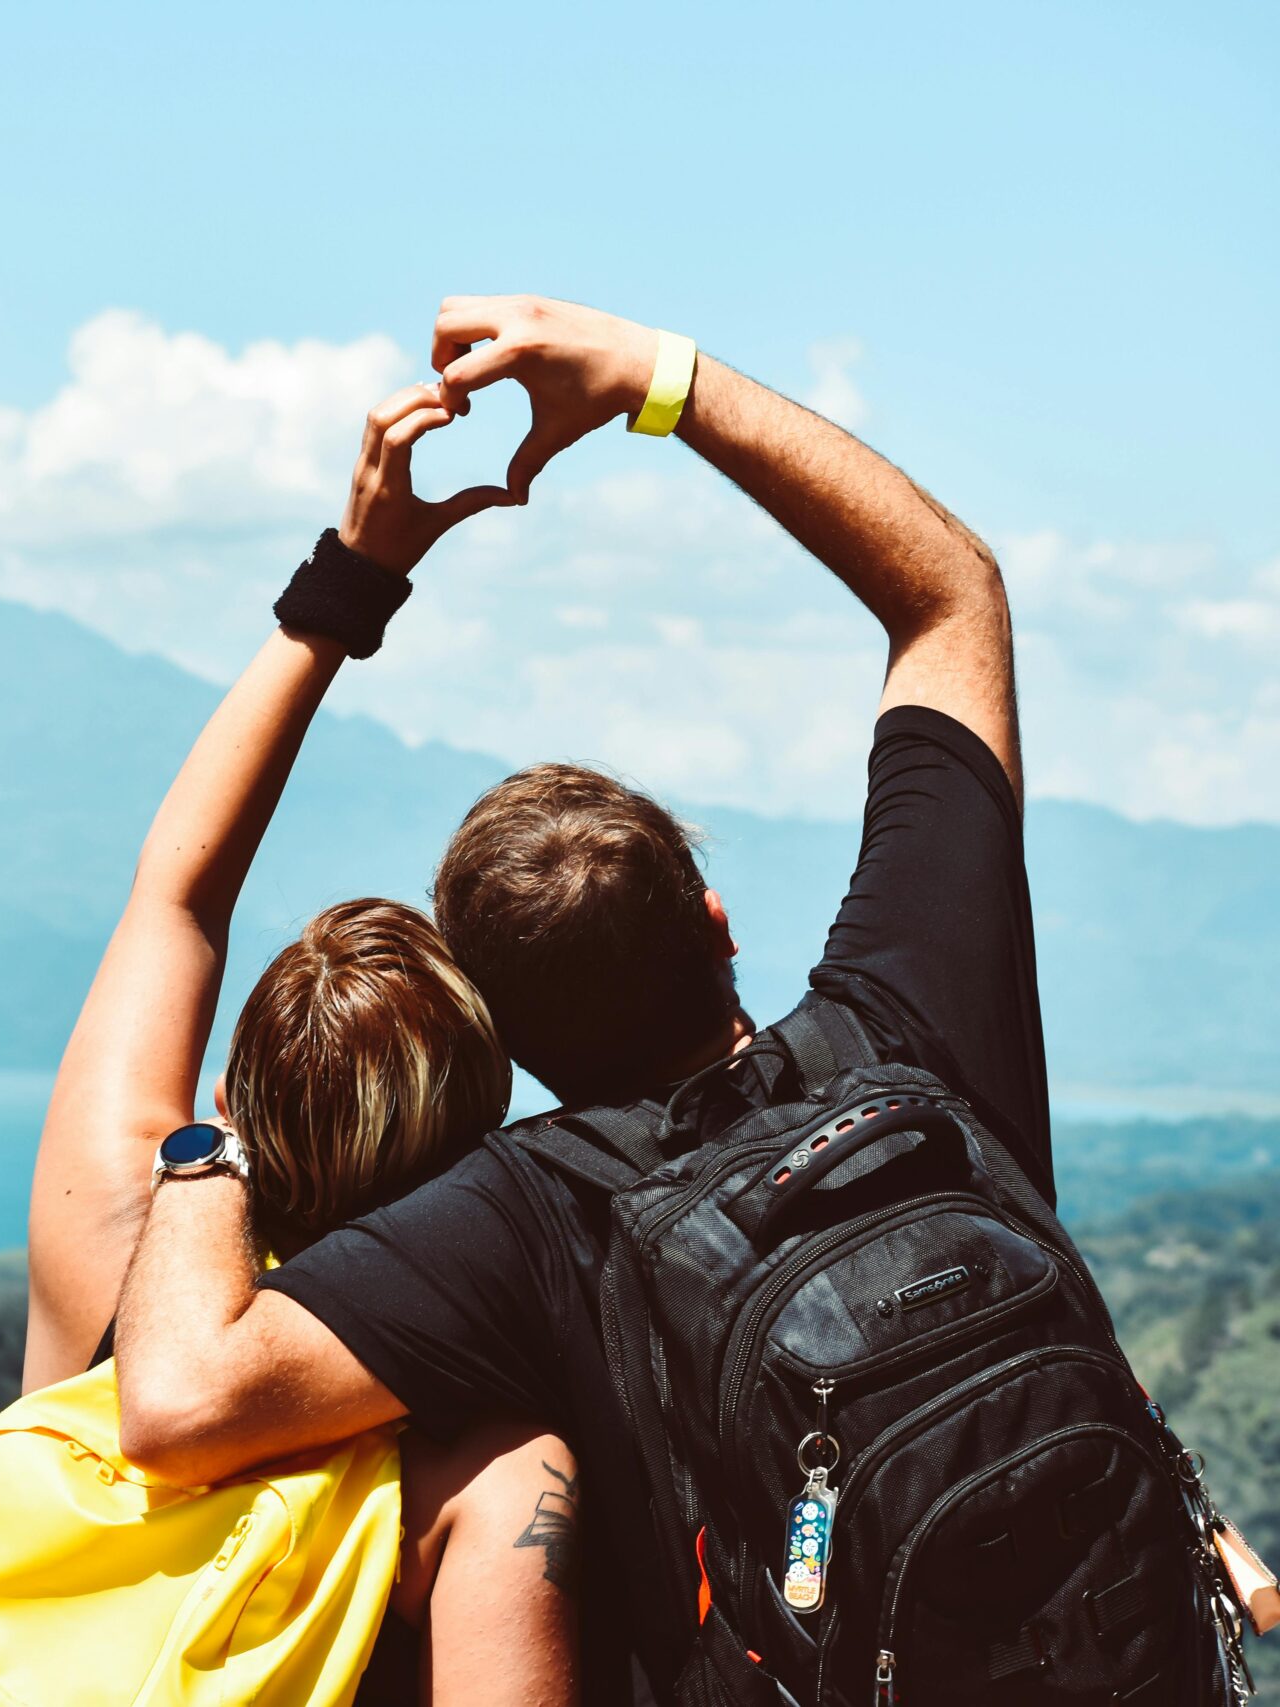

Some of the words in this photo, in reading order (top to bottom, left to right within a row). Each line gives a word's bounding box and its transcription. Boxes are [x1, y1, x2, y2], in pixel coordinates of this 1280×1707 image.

[904, 1273, 962, 1301] Samsonite
[788, 1585, 817, 1594] MYRTLE
[789, 1592, 814, 1600] BEACH
